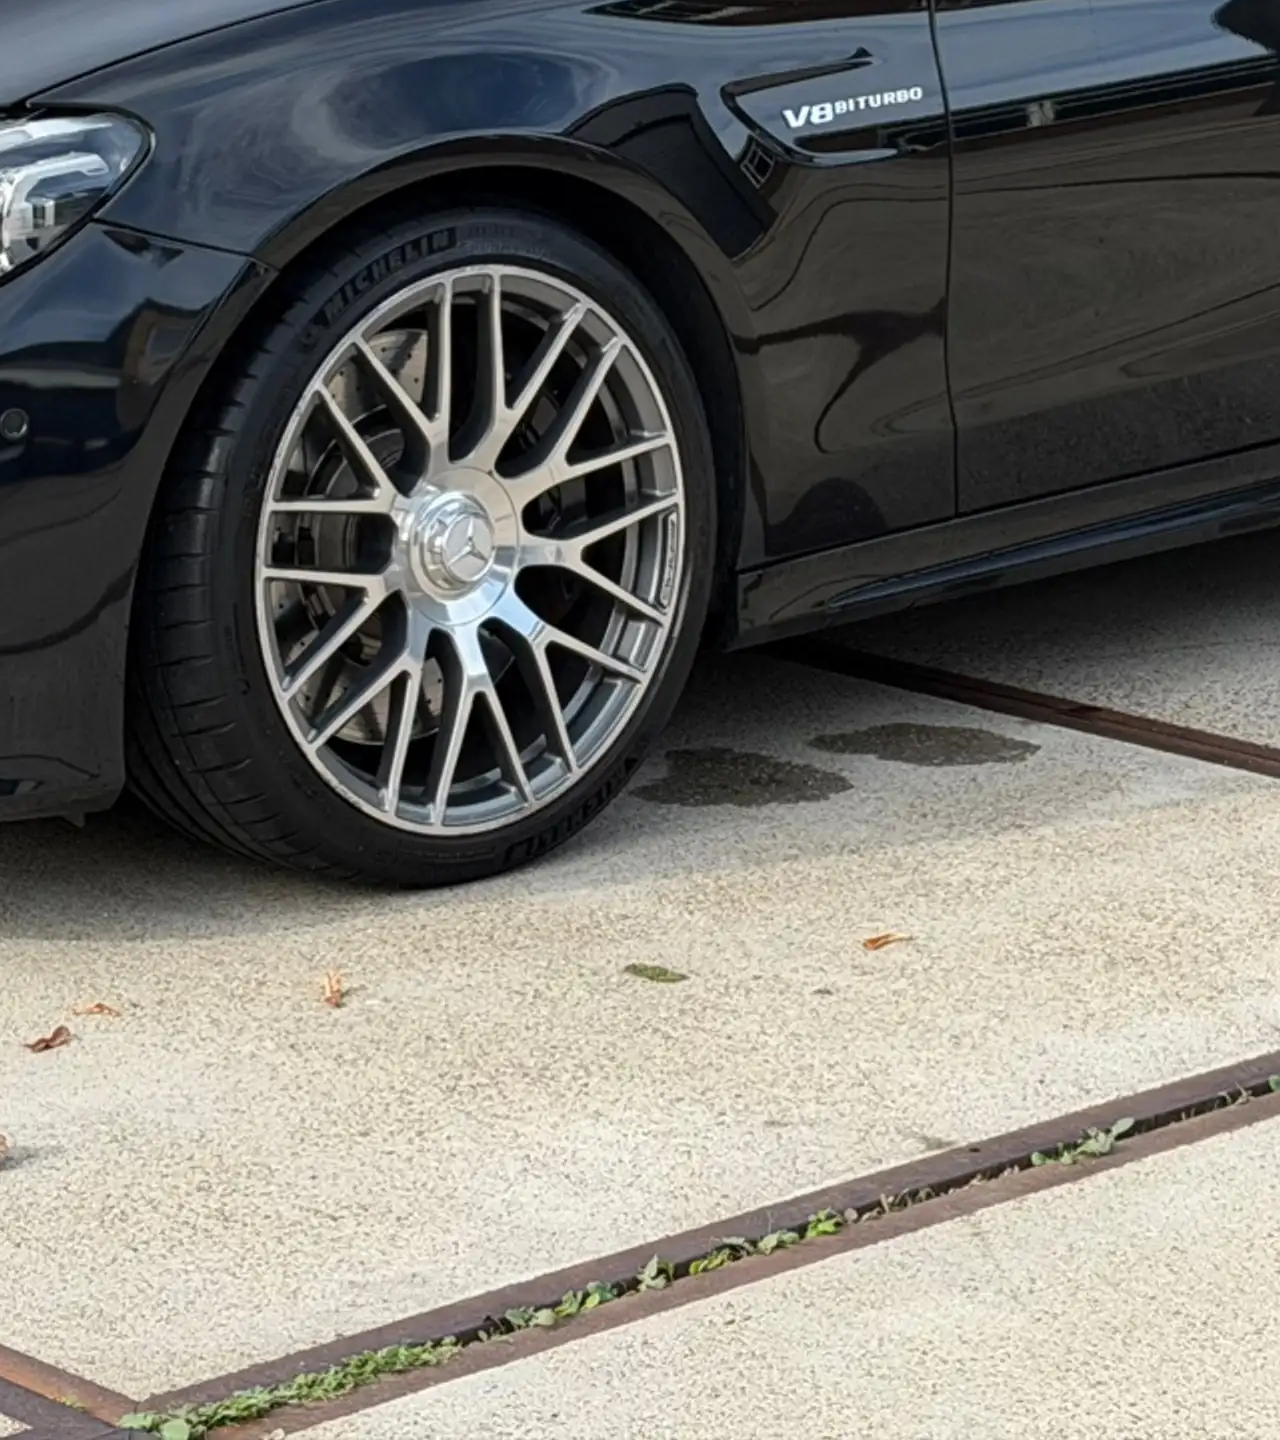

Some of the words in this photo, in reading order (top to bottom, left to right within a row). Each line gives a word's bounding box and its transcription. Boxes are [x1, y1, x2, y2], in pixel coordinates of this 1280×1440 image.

[783, 102, 834, 128] V8
[835, 86, 923, 115] BITURBO
[324, 227, 455, 324] MICHELIN
